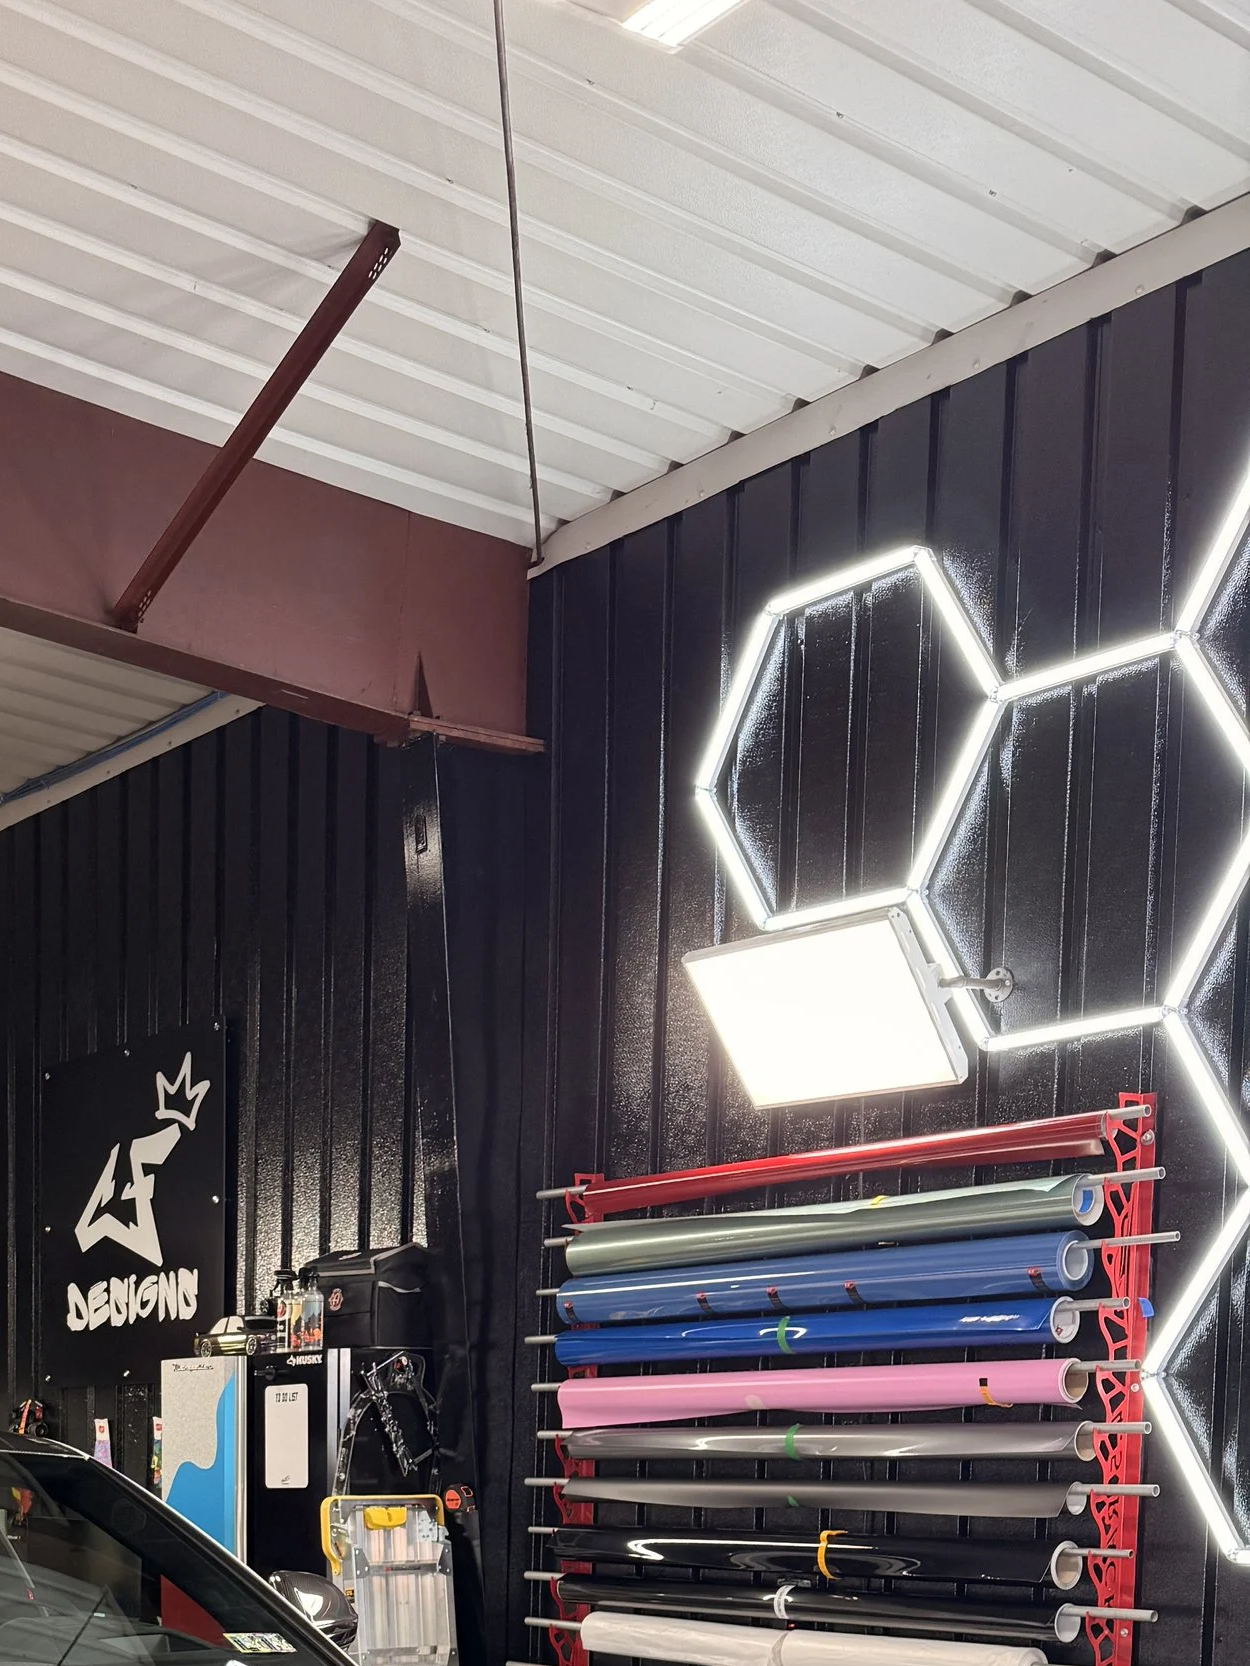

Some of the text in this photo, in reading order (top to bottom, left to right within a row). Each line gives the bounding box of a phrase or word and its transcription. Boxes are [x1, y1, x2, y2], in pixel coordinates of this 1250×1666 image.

[66, 1267, 200, 1332] DESIGNS
[295, 1354, 323, 1366] HUSKY
[288, 1391, 298, 1402] LIST
